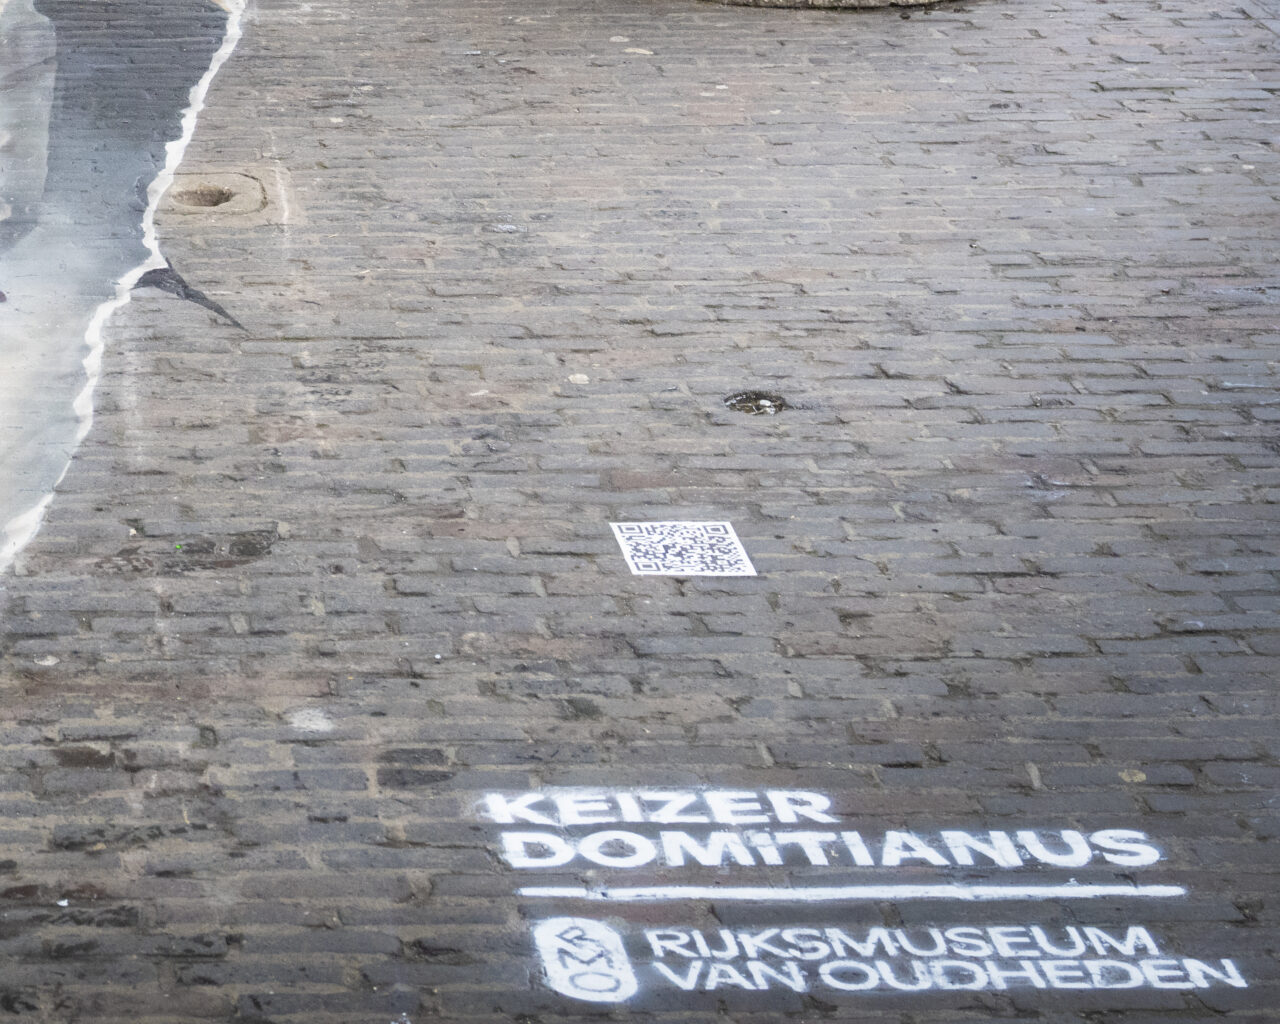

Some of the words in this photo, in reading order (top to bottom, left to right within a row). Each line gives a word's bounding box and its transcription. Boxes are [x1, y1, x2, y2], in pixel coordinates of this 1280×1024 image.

[485, 789, 841, 825] KEIZER
[644, 926, 1160, 961] RIJKSMUSEUM
[653, 959, 811, 993] VAN
[819, 957, 1249, 992] OUDHEDEN
